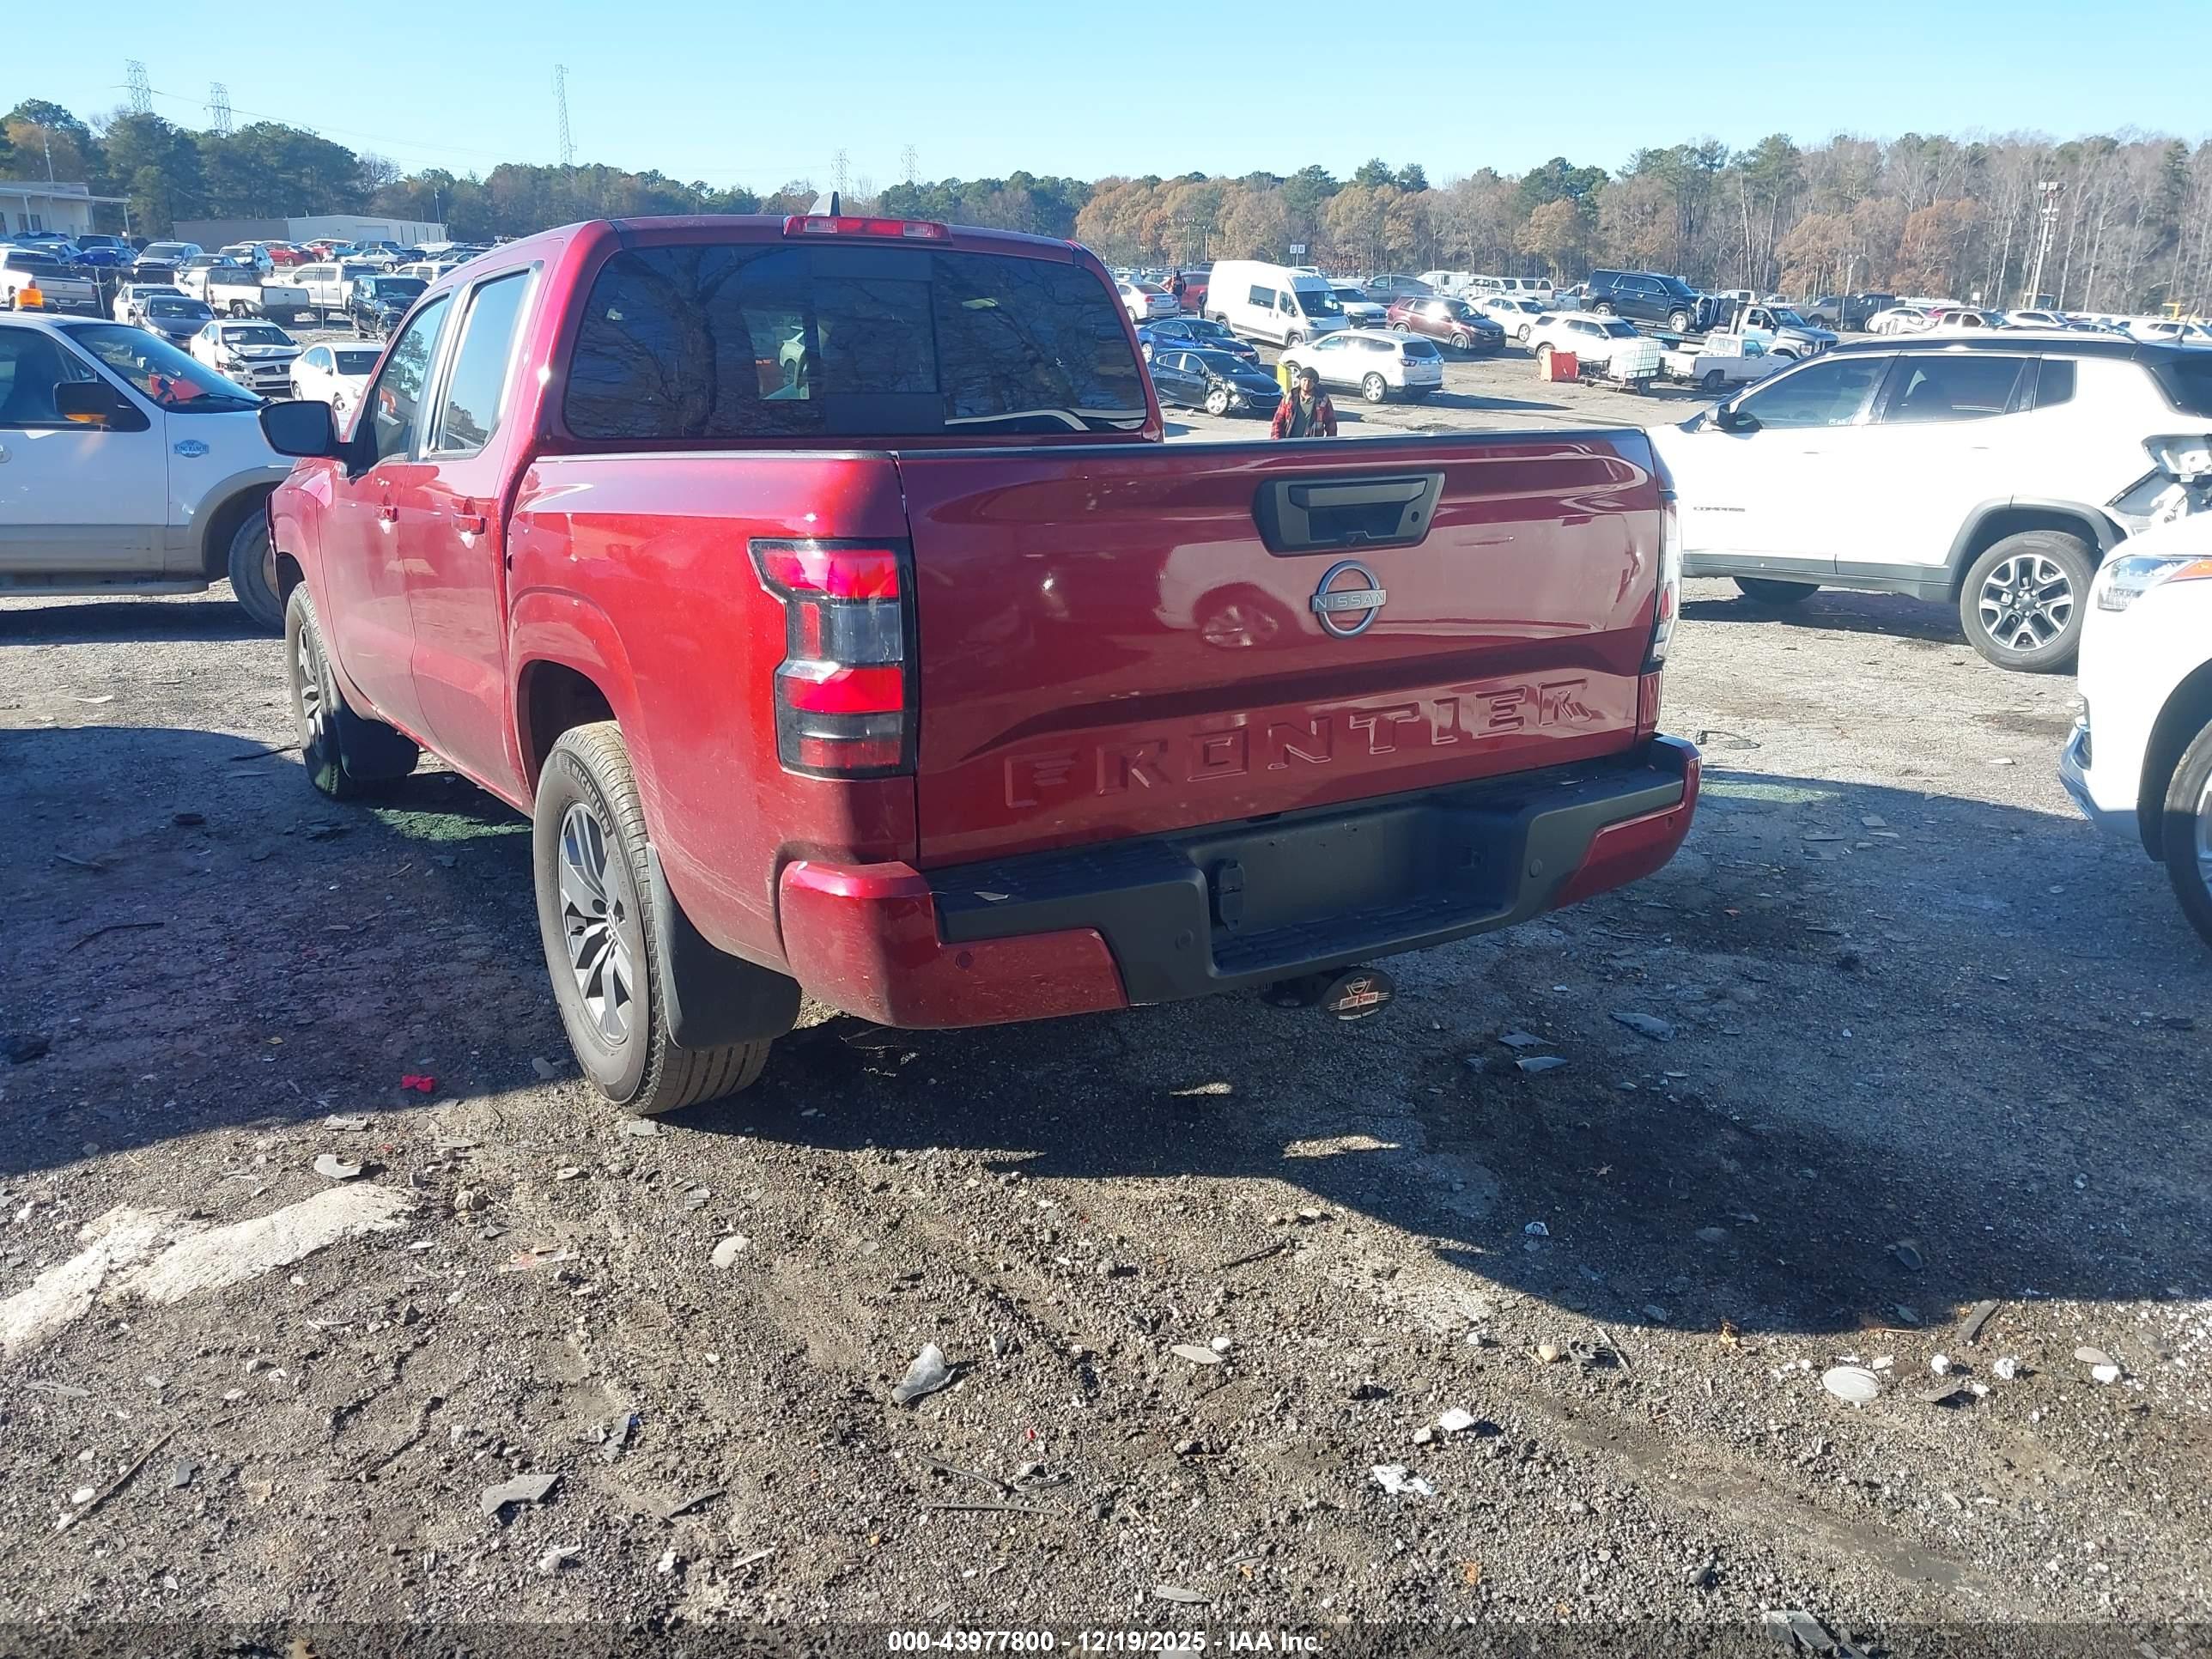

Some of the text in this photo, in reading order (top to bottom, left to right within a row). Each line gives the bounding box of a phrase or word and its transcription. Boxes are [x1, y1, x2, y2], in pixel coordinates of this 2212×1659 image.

[1315, 592, 1384, 609] NISSAN
[1005, 679, 1593, 810] FRONTIER
[570, 763, 611, 835] MICHELIN
